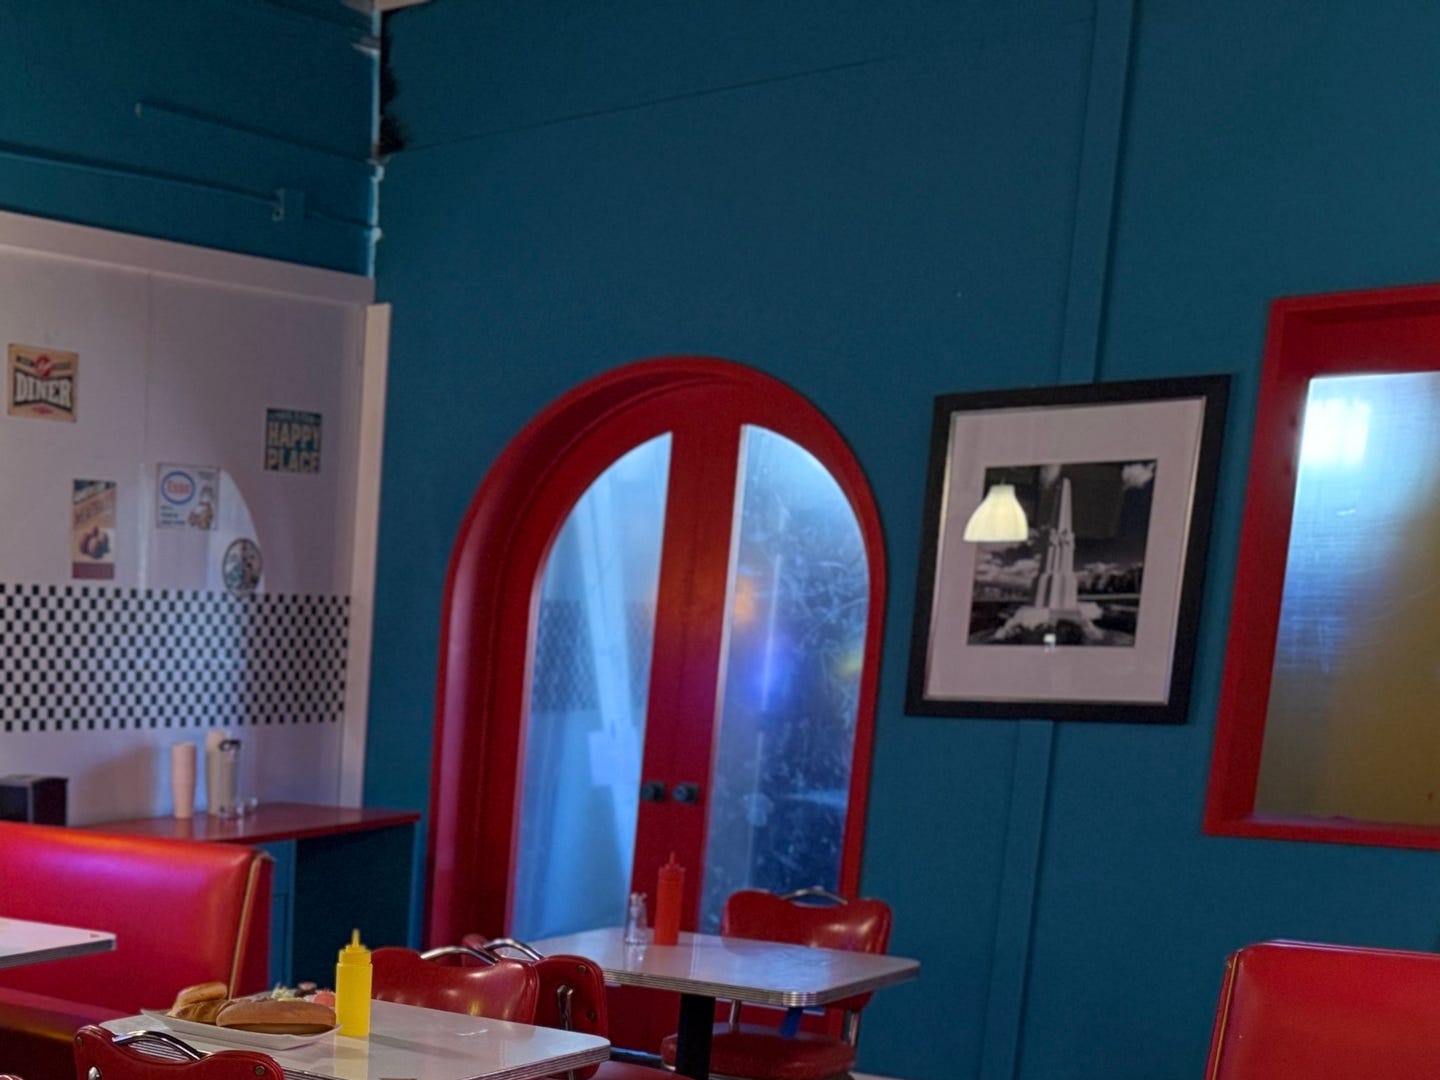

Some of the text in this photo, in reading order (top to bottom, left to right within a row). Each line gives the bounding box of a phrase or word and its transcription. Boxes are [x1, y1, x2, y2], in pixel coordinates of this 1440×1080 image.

[16, 372, 71, 408] DINER
[269, 422, 320, 450] HAPPY
[268, 449, 320, 474] PLACE
